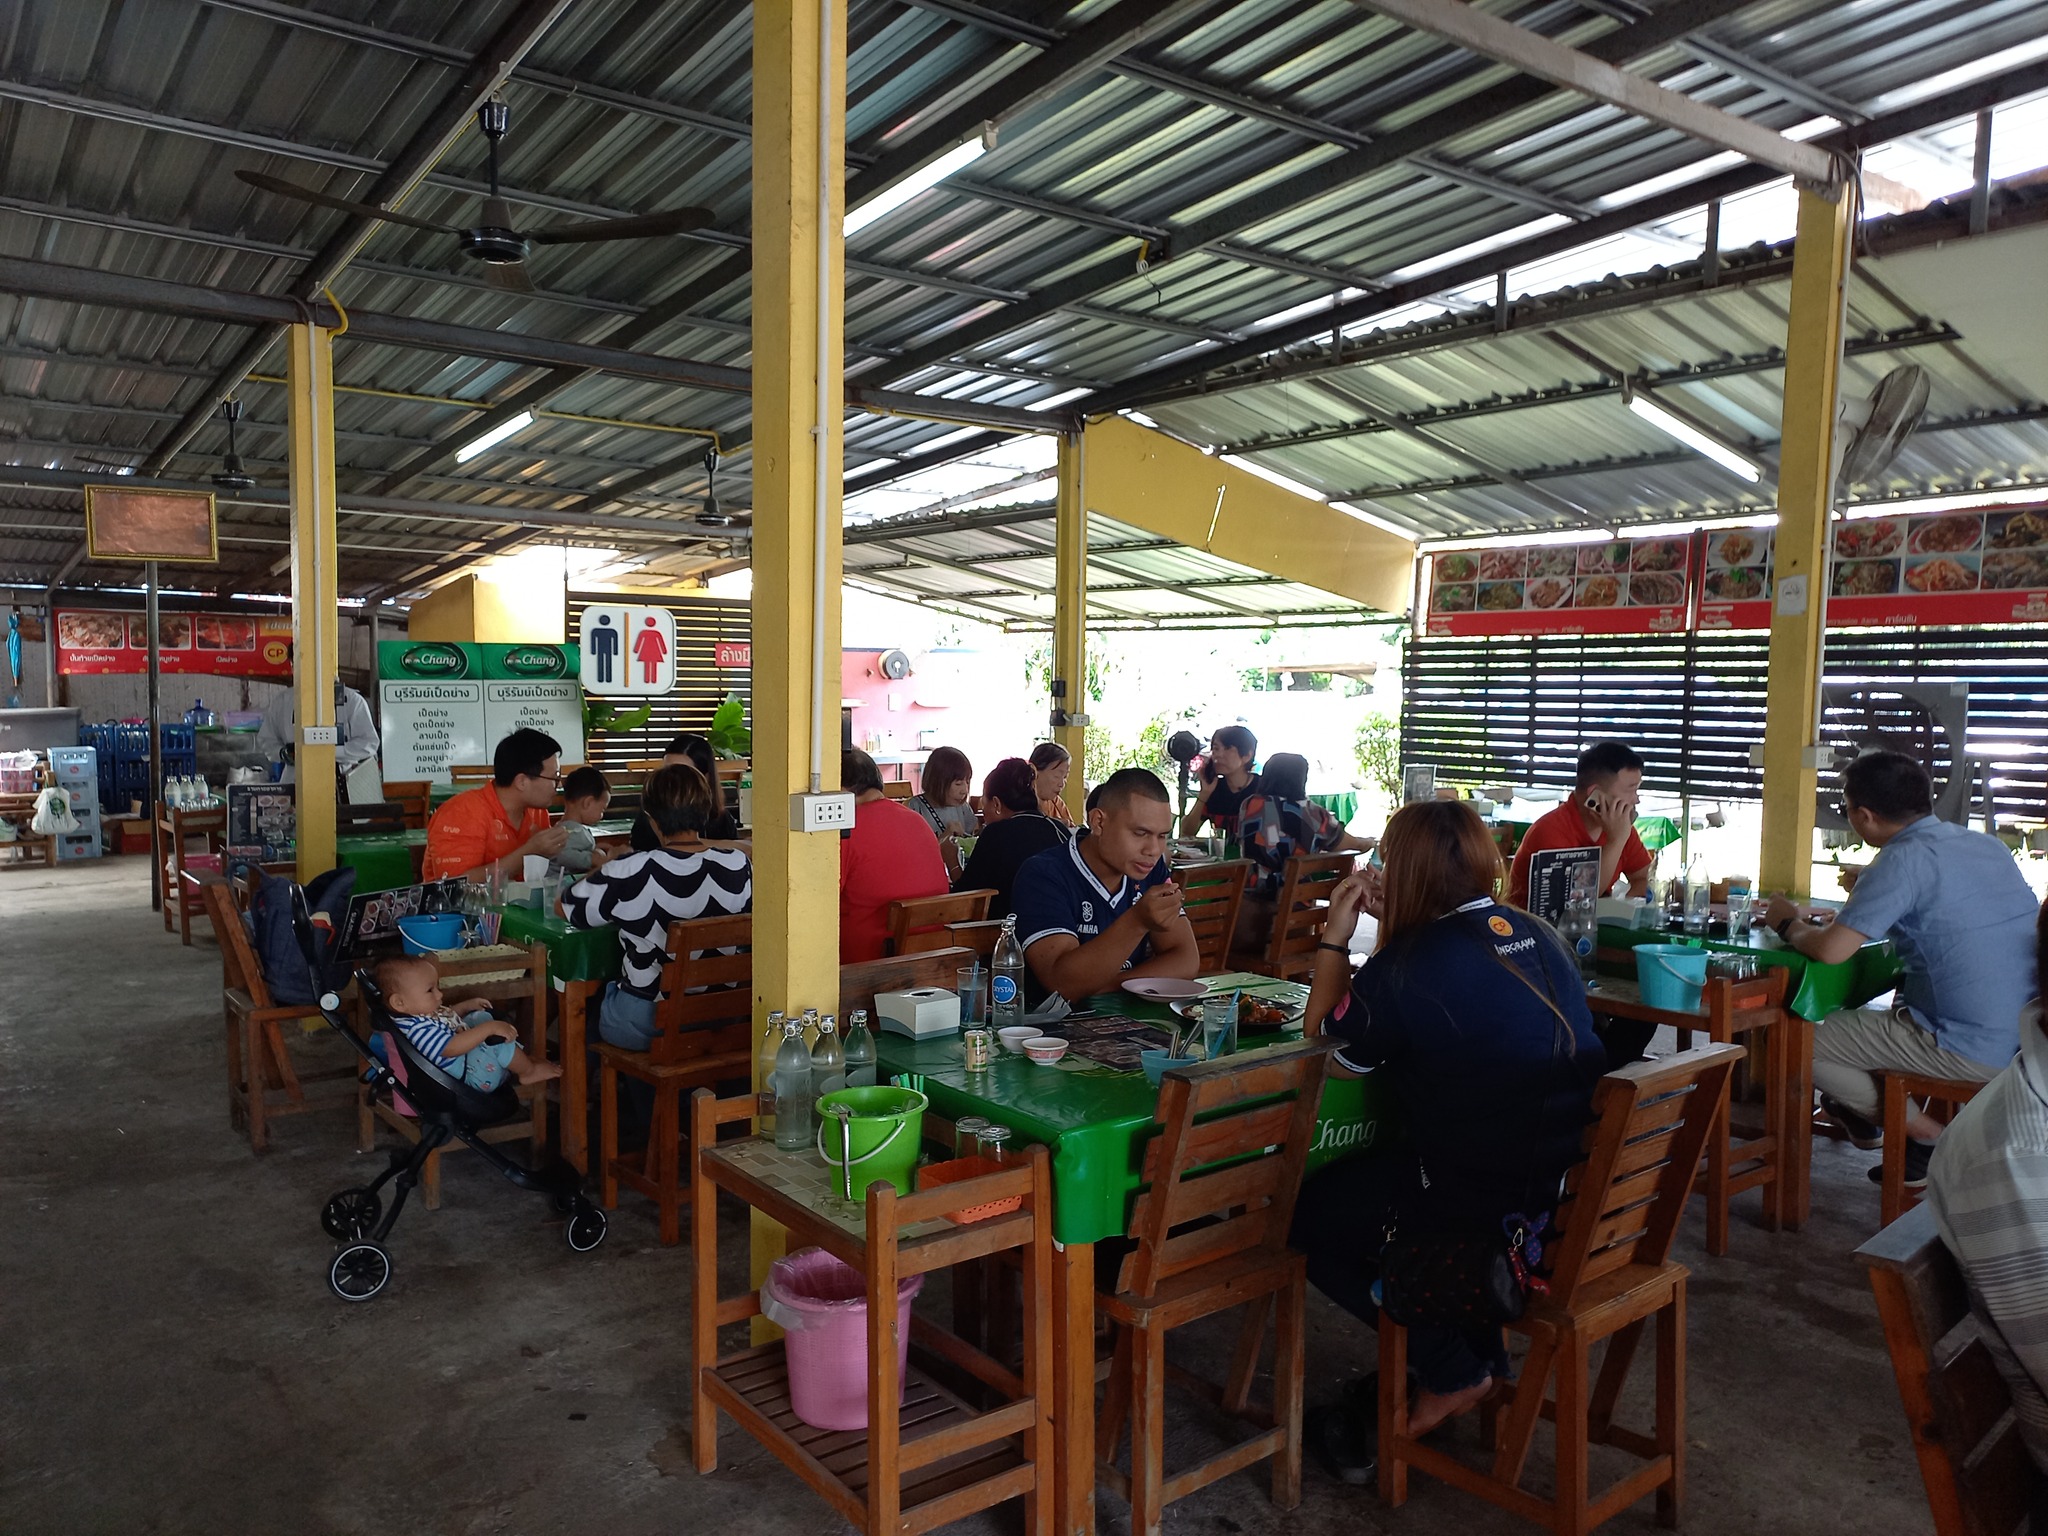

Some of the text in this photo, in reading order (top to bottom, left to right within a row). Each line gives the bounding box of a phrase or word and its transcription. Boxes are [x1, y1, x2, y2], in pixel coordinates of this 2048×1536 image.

[268, 648, 284, 658] CP
[421, 653, 457, 668] Chang
[522, 654, 556, 668] Chang
[394, 686, 470, 702] บุรีรัมย์เป็ดย่าง
[497, 685, 569, 701] บุรีรัมย์เป็ดย่าง
[418, 708, 448, 717] เป็ดย่าง
[520, 706, 549, 716] เป็ดย่าง
[412, 719, 455, 731] ตูดเป็ดย่าง
[419, 730, 449, 740] ลาบเป็ด
[416, 753, 453, 764] คอหมูย่าง
